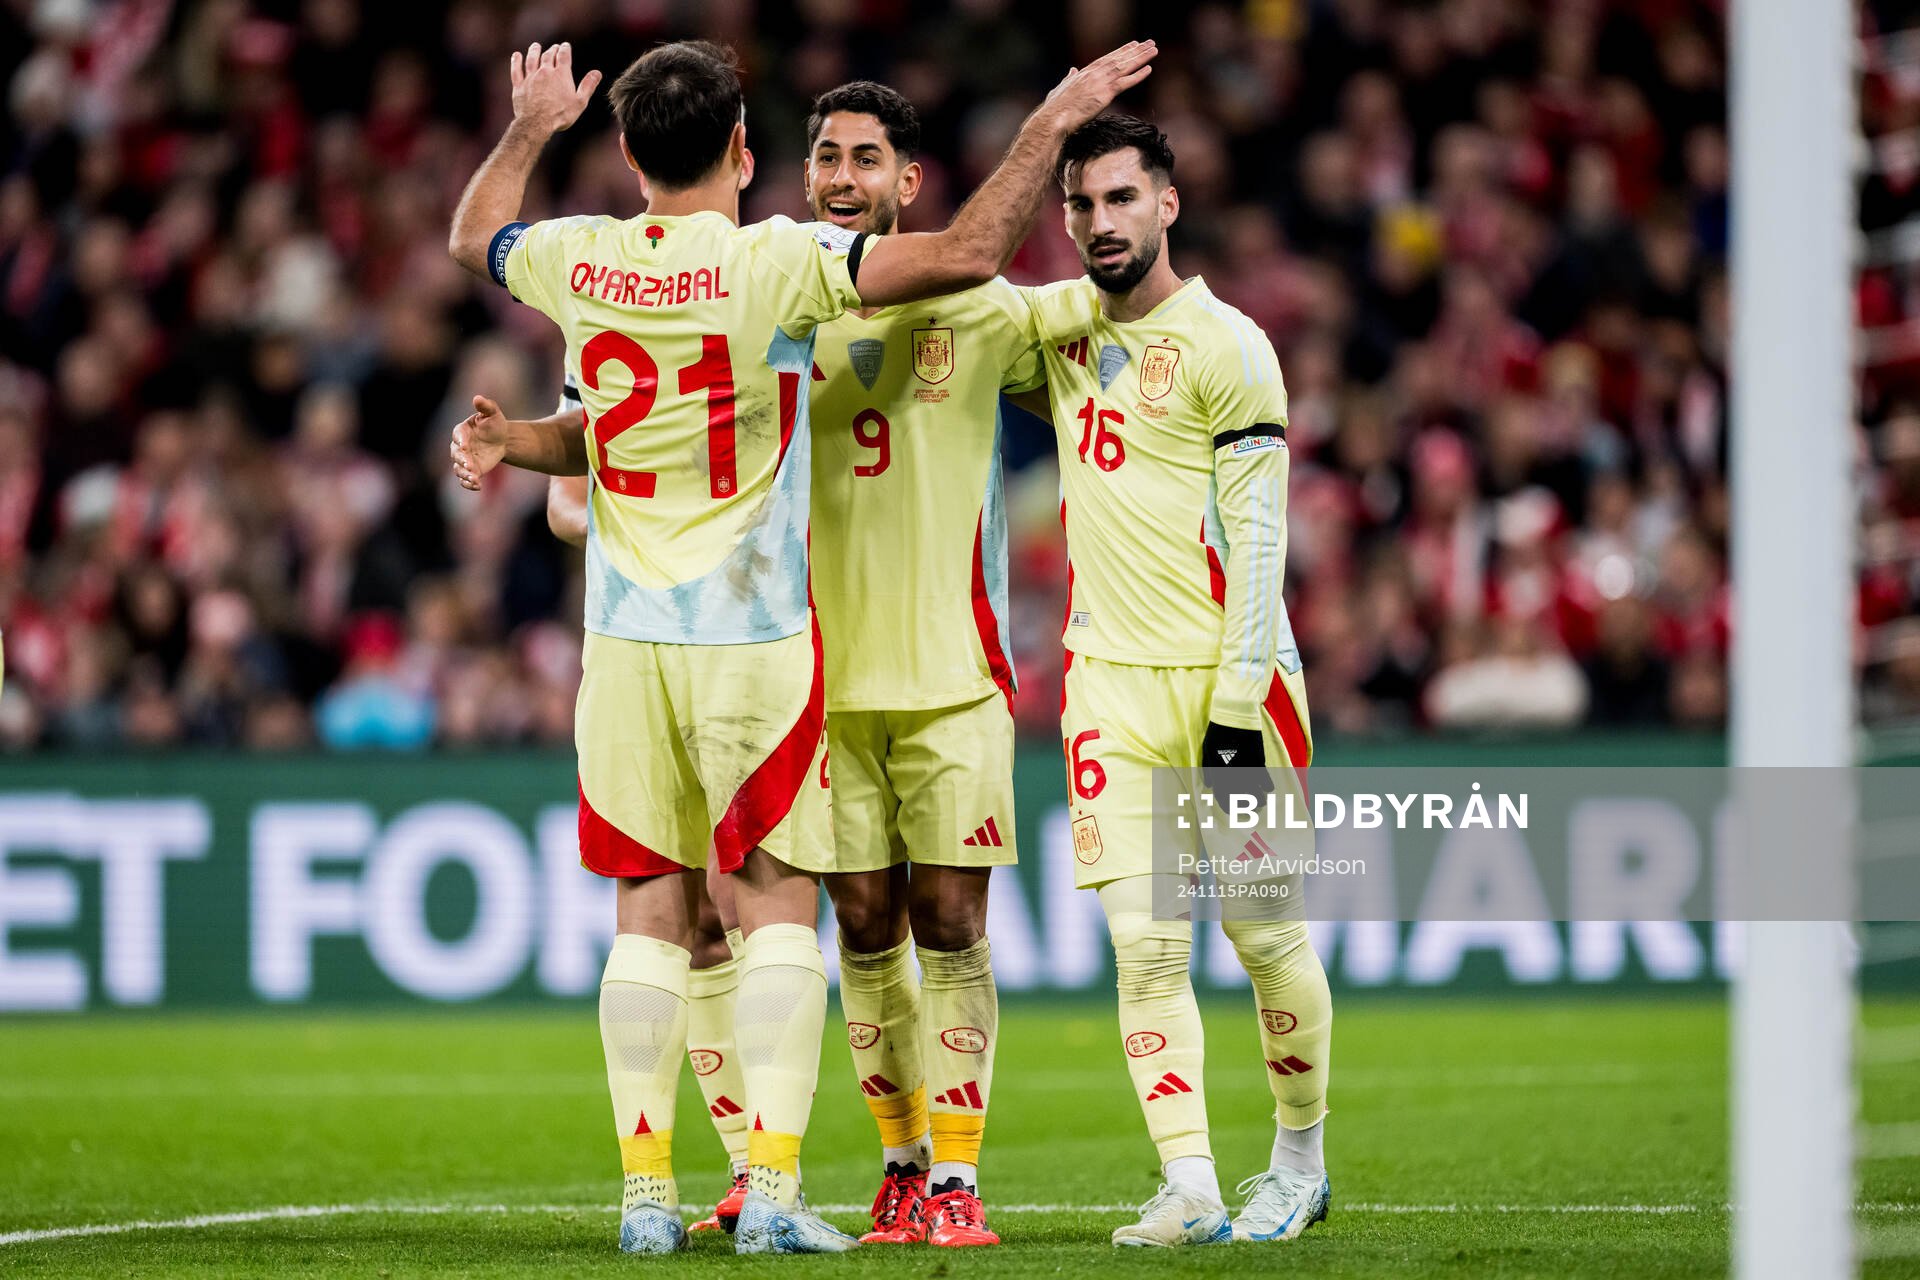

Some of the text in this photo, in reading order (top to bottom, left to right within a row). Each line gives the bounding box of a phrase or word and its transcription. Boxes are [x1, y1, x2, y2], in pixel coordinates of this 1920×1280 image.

[497, 238, 511, 283] RESPEC
[571, 262, 729, 307] OYARZABAL
[581, 330, 738, 499] 21
[853, 408, 890, 477] 9
[1077, 397, 1125, 472] 16
